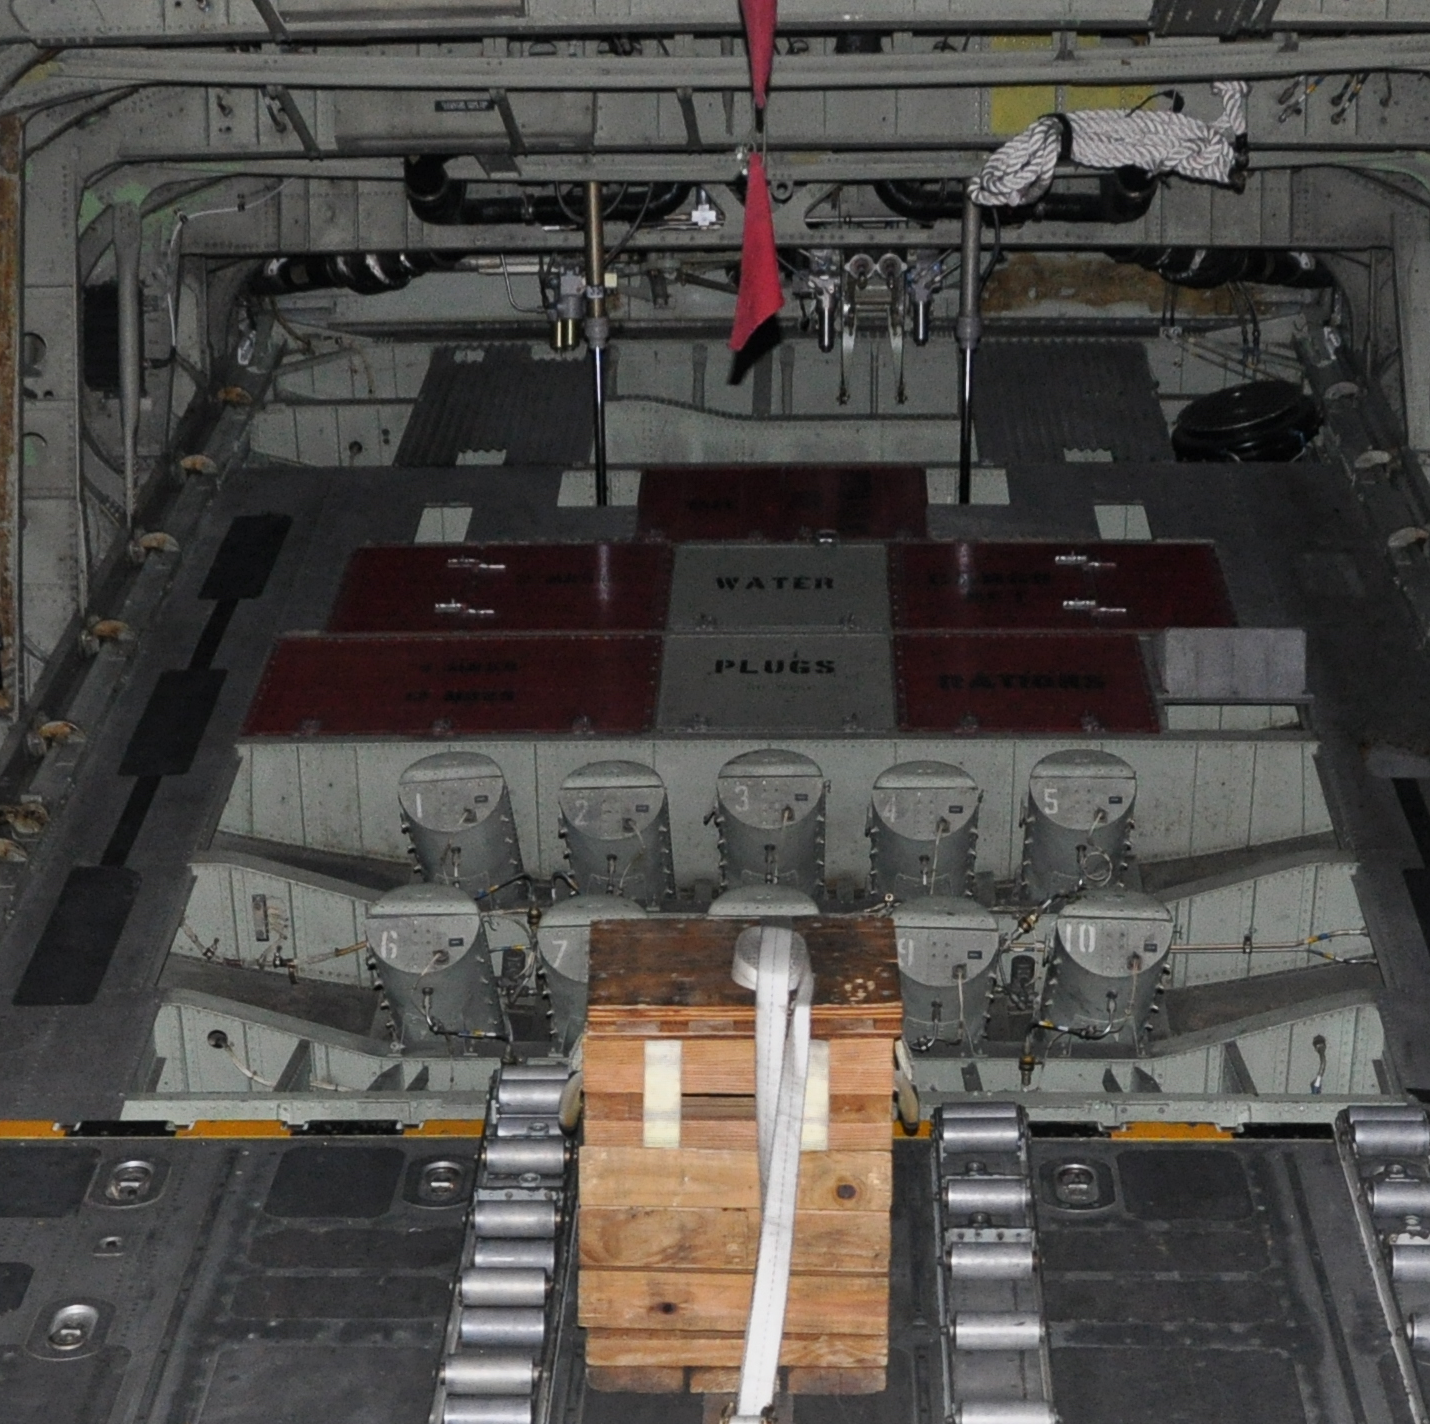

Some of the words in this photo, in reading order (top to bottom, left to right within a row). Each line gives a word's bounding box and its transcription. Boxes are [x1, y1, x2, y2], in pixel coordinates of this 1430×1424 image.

[716, 576, 834, 591] WATER
[714, 658, 836, 675] PLUGS
[415, 793, 423, 818] 1
[734, 785, 749, 811] 3
[883, 794, 897, 823] 4
[1043, 788, 1059, 815] 5
[574, 799, 590, 826] 2
[380, 930, 399, 959] 6
[1064, 923, 1097, 953] 10
[551, 939, 569, 968] 7
